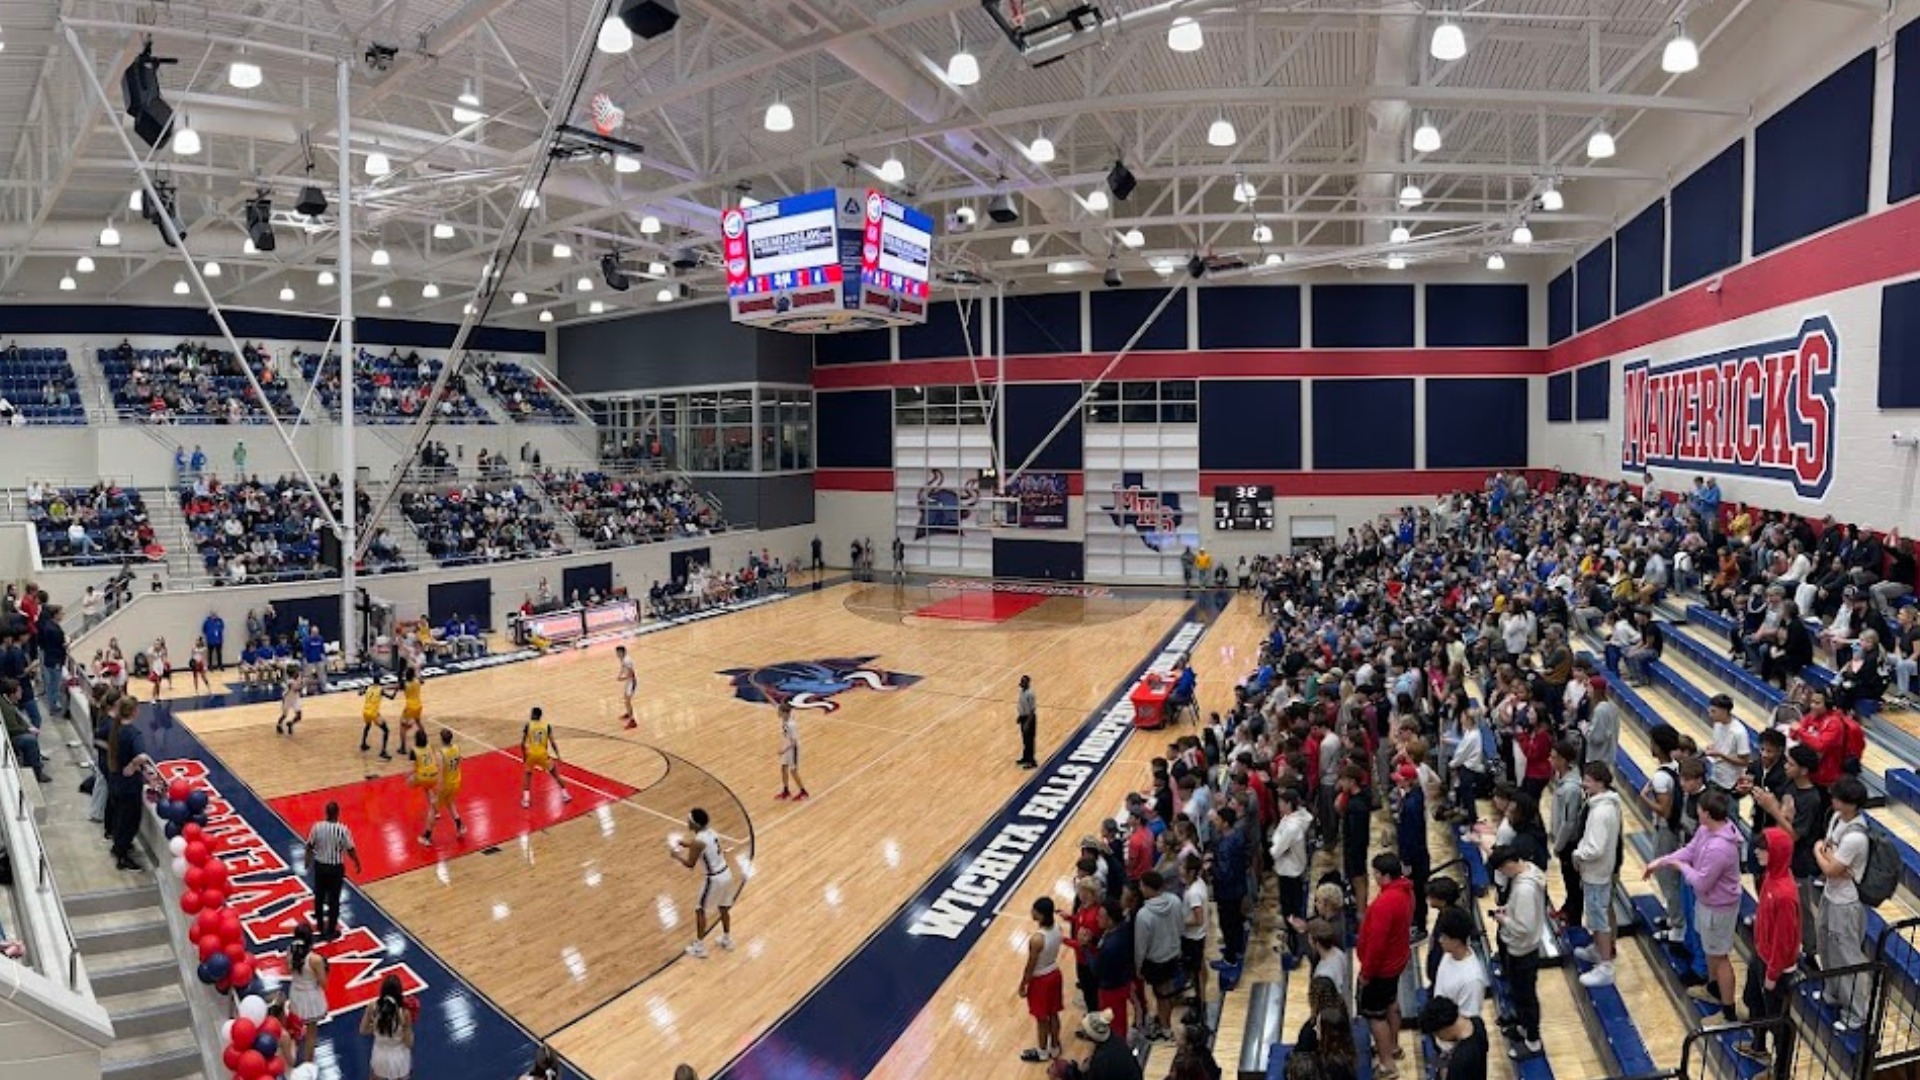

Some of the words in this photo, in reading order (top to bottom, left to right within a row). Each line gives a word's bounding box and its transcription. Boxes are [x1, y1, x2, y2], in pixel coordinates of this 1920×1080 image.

[1623, 329, 1832, 486] MAVERICKS
[907, 823, 1048, 939] WICHITA
[1018, 763, 1093, 820] FALLS
